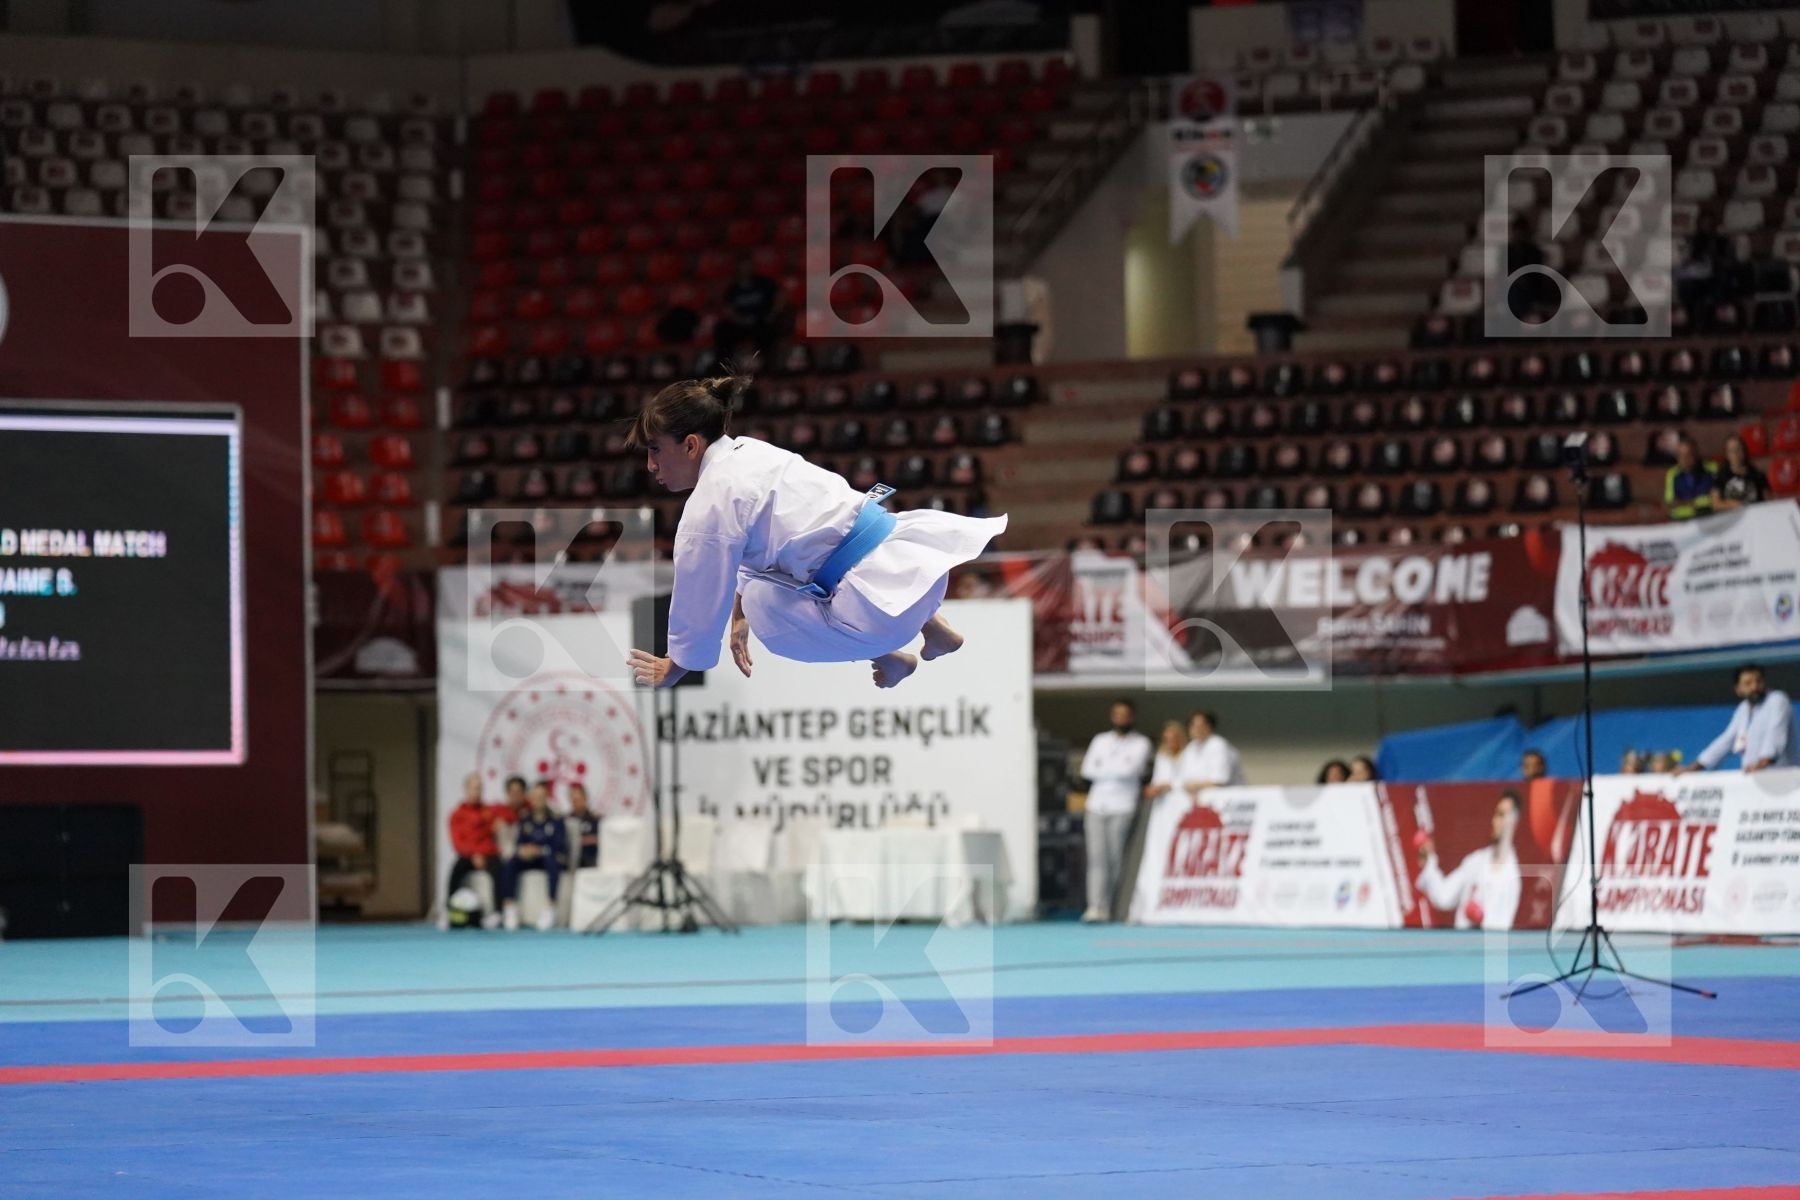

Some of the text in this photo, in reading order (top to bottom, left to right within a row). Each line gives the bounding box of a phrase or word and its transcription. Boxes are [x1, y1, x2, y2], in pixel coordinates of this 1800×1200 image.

[20, 528, 91, 557] MEDAL
[93, 529, 167, 558] MATCH
[1231, 552, 1491, 608] WELCOME
[657, 698, 990, 747] GAZİANTEP GENÇLİK
[753, 755, 893, 786] VE SPOR
[1600, 821, 1718, 878] KARATE
